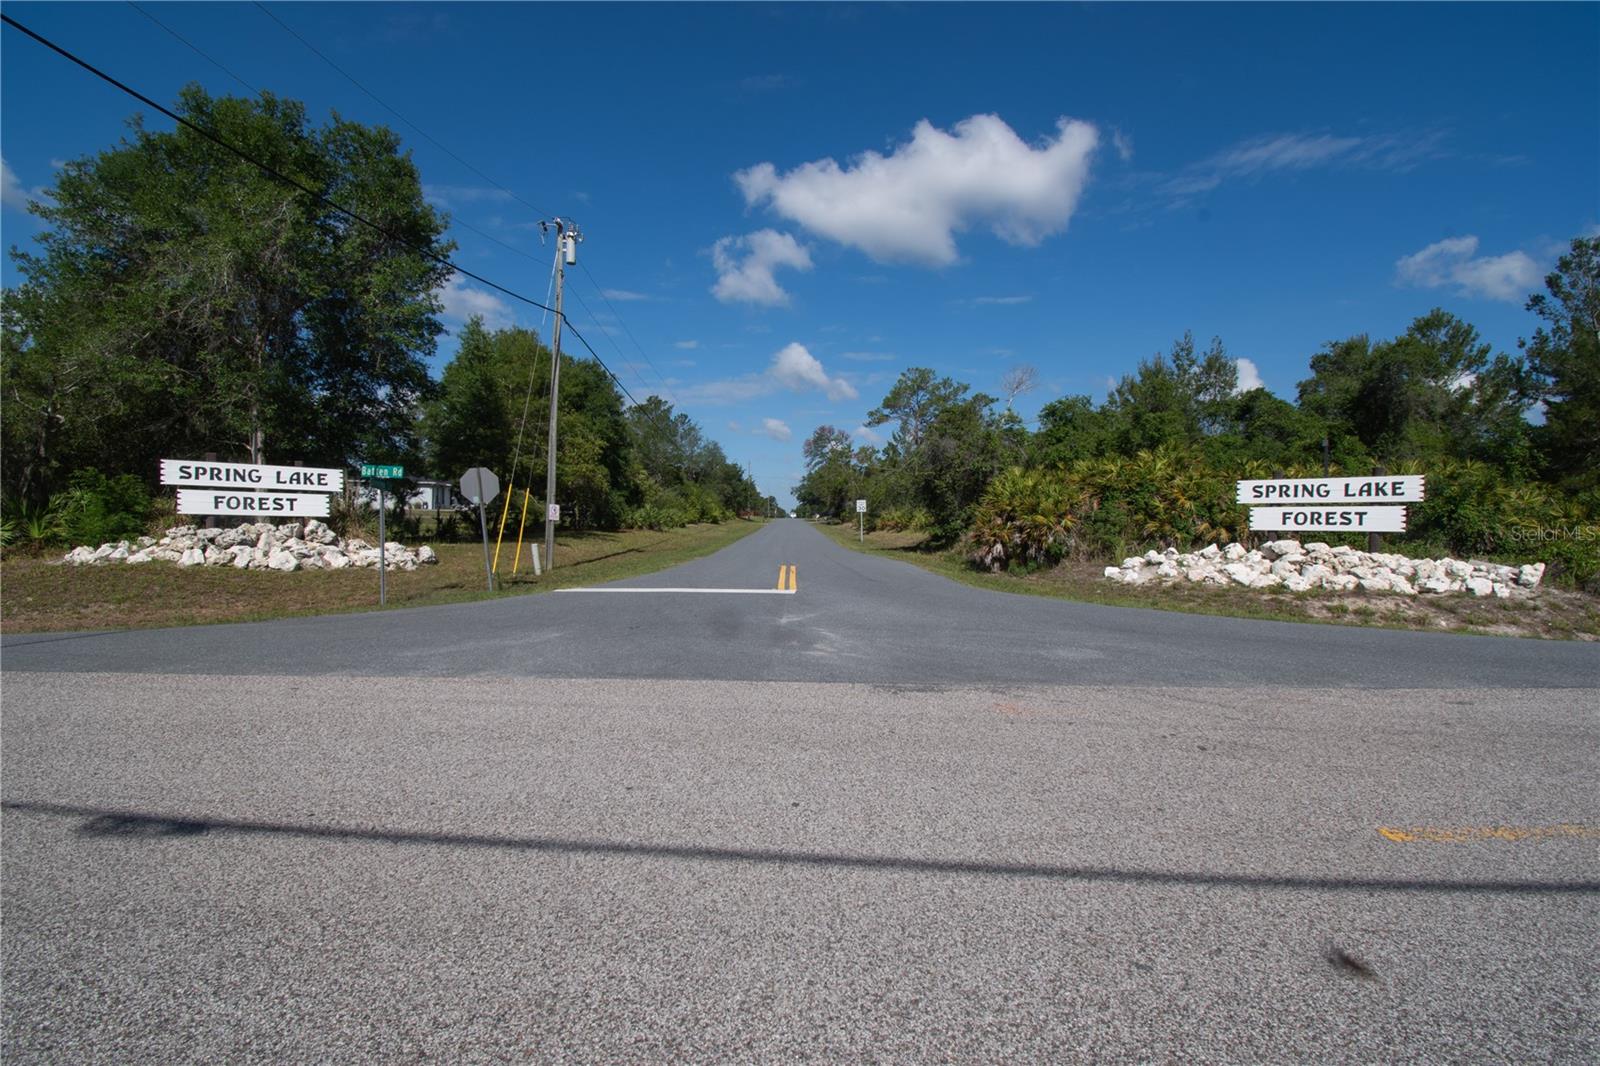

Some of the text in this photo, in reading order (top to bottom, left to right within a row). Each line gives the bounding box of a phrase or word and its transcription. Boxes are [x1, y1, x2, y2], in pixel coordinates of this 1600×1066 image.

[178, 465, 328, 486] SPRING LAKE
[392, 467, 404, 477] Rd
[1252, 481, 1405, 498] SPRING LAKE
[214, 495, 298, 511] FOREST
[1282, 511, 1368, 526] FOREST
